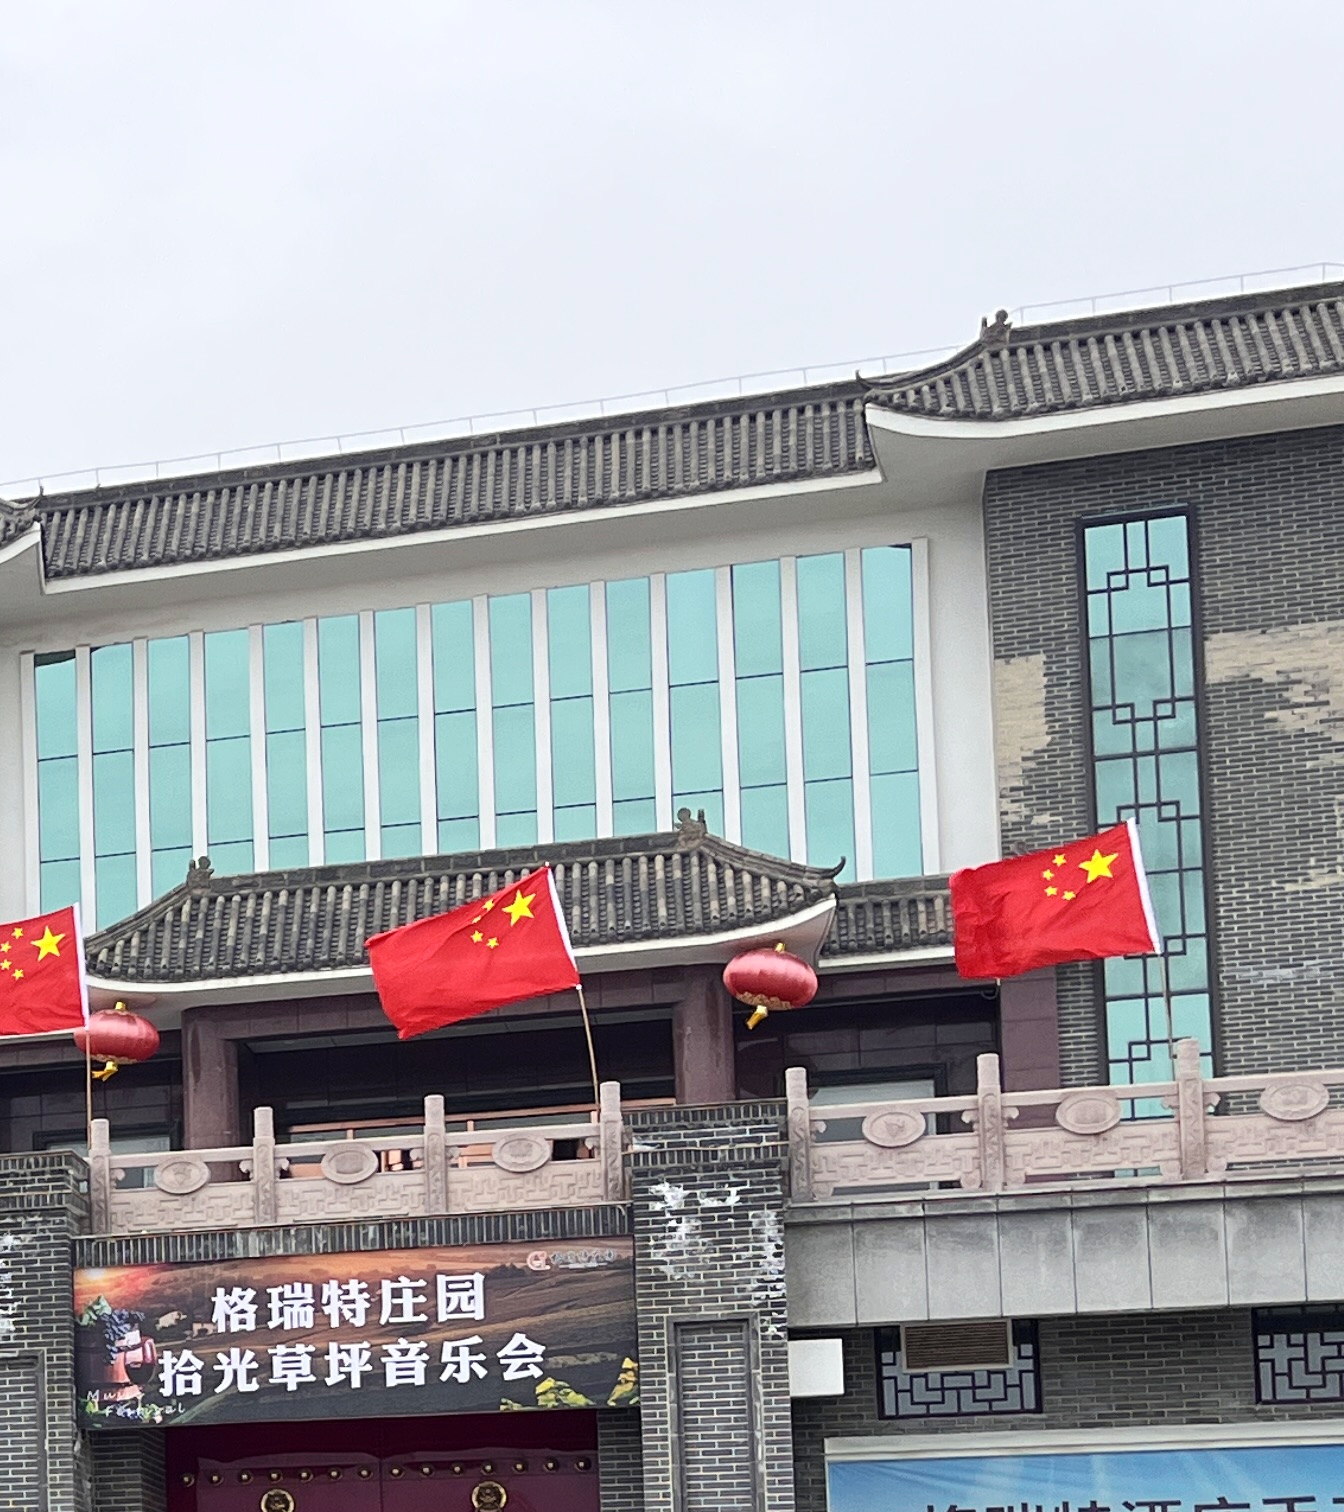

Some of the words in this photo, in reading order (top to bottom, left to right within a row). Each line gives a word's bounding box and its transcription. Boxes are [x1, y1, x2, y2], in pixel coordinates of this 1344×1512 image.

[211, 1271, 486, 1334] 格瑞特庄园
[159, 1332, 547, 1398] 拾光草坪音乐会
